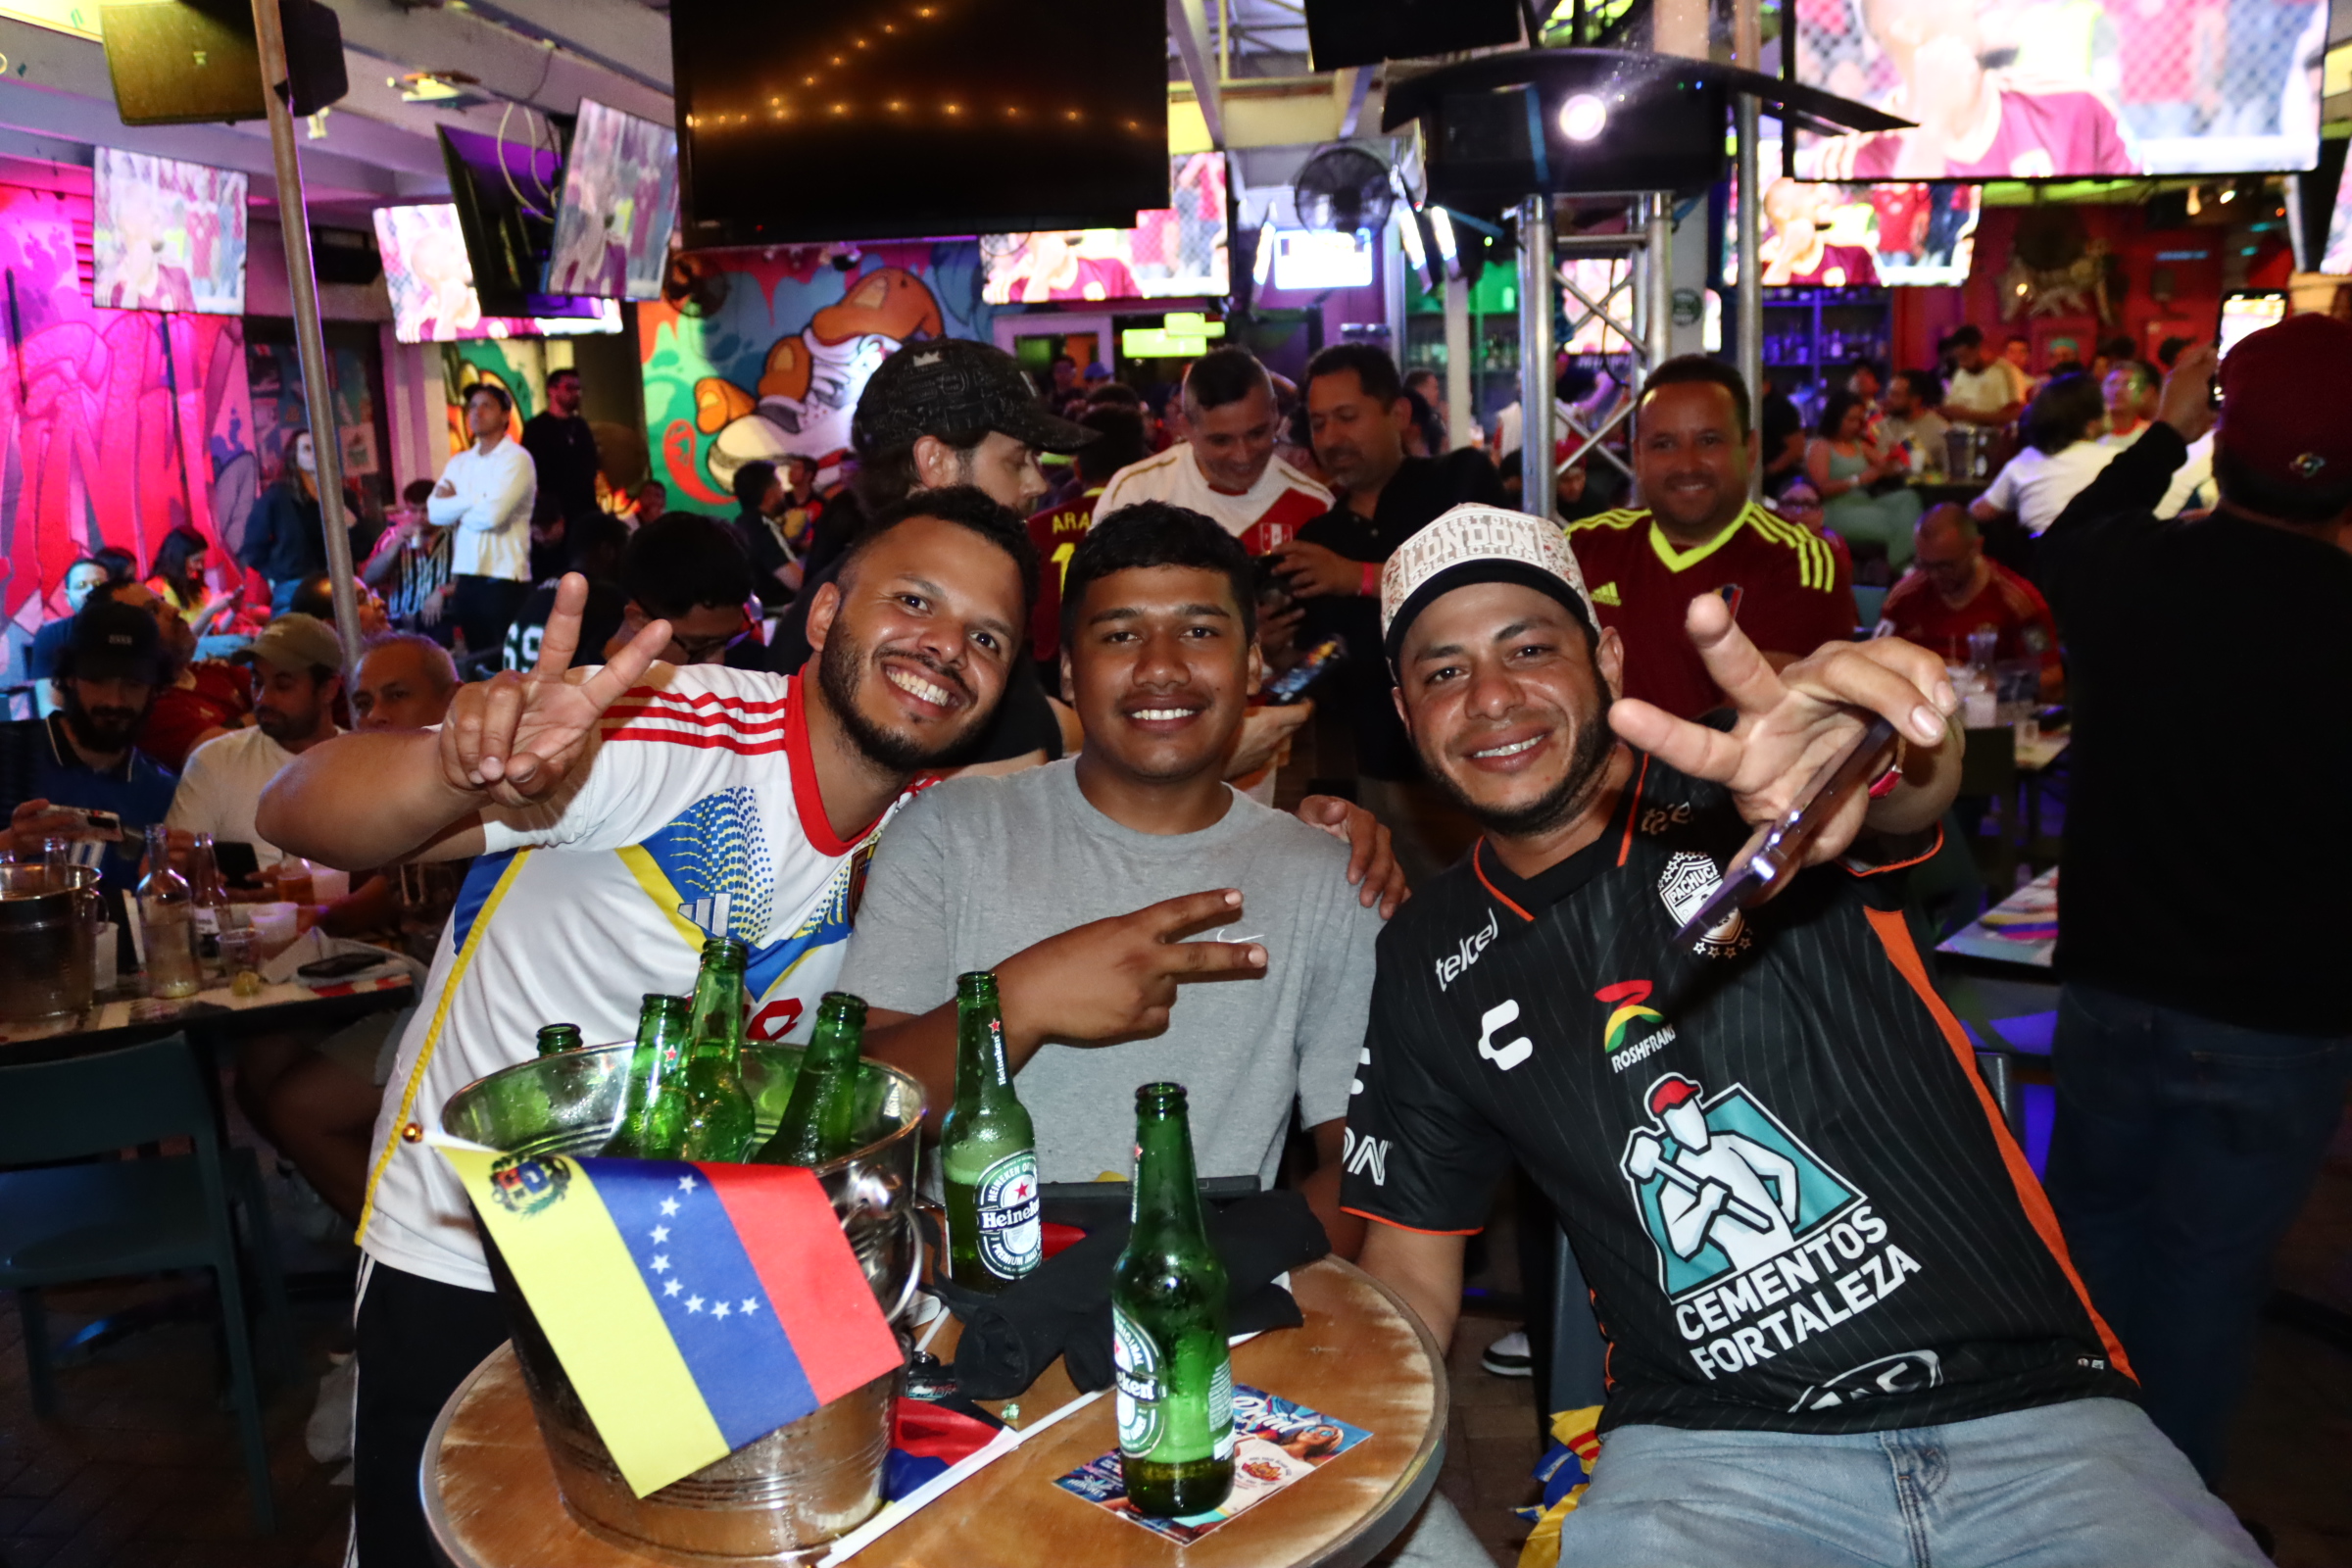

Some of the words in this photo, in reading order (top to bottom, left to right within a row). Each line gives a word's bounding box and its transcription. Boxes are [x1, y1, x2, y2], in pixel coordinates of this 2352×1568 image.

[1404, 530, 1433, 552] THE
[1438, 515, 1484, 533] BEST
[1491, 515, 1533, 535] CITY
[1406, 522, 1536, 576] LONDON
[1408, 545, 1539, 584] COLLECTION
[1436, 906, 1498, 992] telcel
[1611, 1023, 1676, 1073] ROSHFRANS
[1676, 1206, 1887, 1341] CEMENTOS
[1690, 1244, 1922, 1380] FORTALEZA
